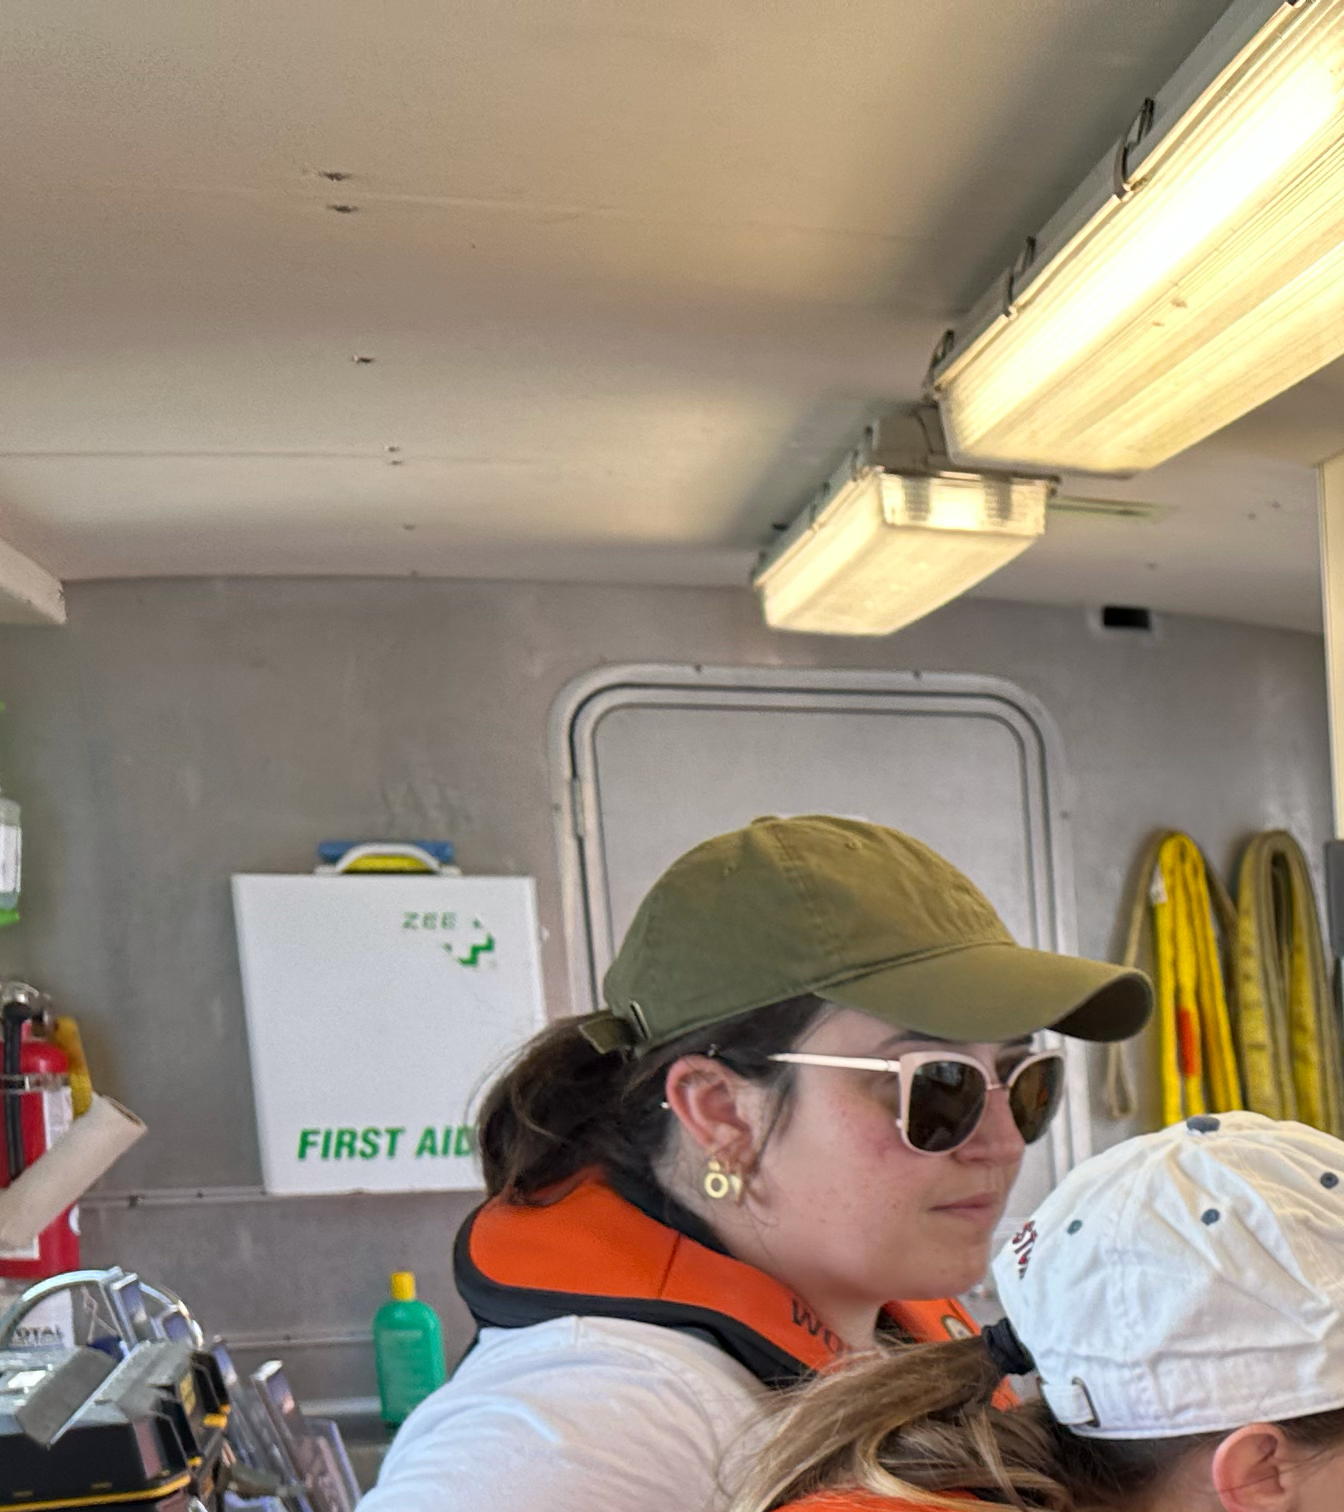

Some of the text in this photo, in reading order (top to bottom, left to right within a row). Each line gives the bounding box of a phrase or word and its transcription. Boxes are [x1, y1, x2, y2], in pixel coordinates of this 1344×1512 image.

[401, 910, 456, 930] ZEE
[297, 1125, 475, 1160] FIRST AID
